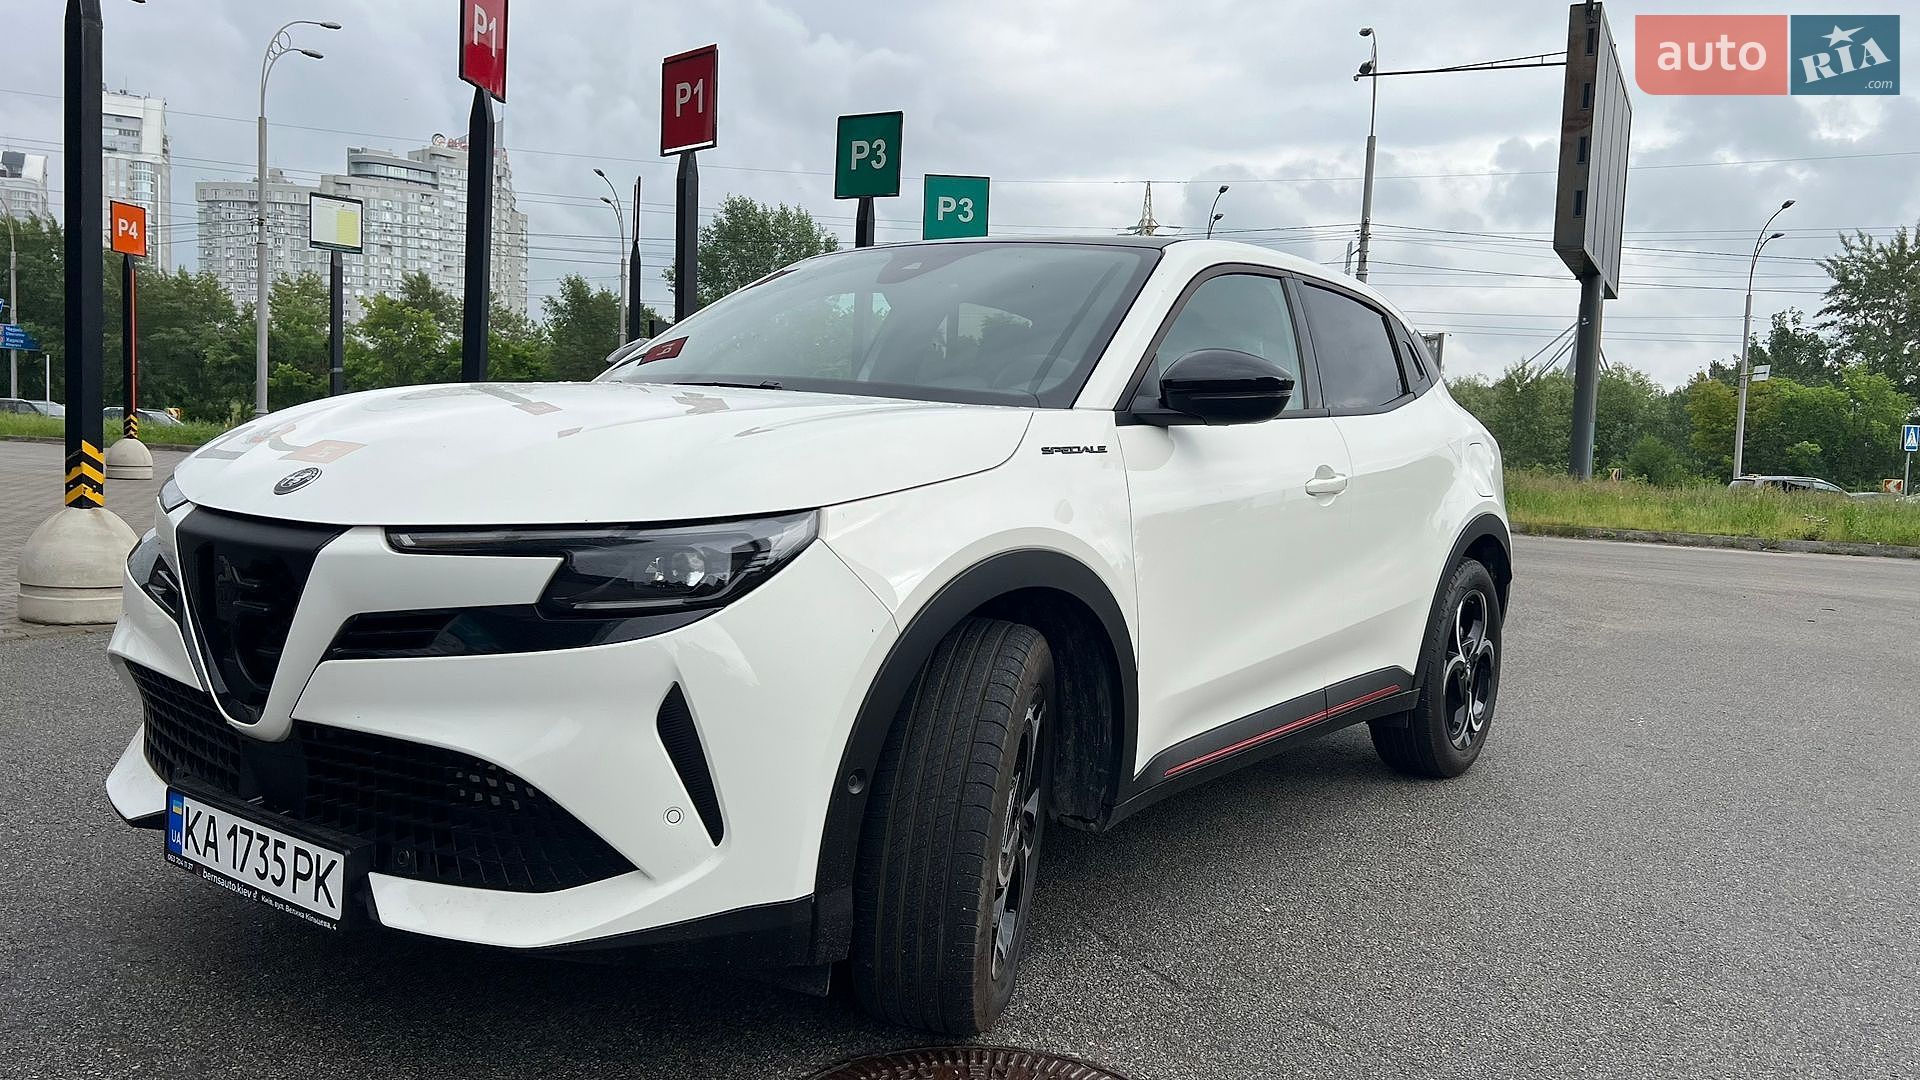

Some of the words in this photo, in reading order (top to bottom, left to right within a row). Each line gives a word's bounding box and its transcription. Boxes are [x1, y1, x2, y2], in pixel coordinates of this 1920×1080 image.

[473, 3, 497, 58] P1
[675, 78, 703, 117] P1
[851, 138, 887, 170] P3
[937, 196, 974, 223] P3
[118, 218, 138, 240] P4
[1041, 445, 1108, 455] SPECIALE
[171, 829, 181, 845] UA
[184, 806, 220, 863] KA
[227, 824, 287, 888] 1735
[292, 845, 338, 909] PK
